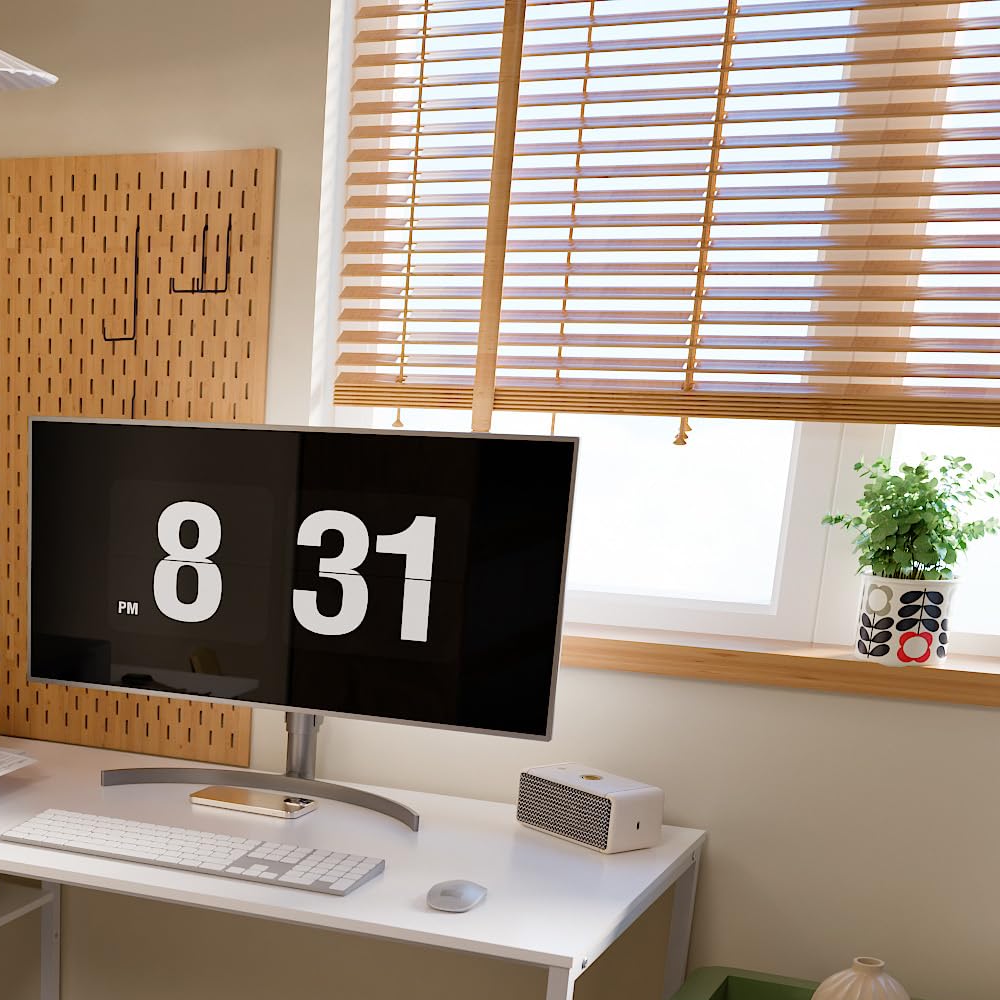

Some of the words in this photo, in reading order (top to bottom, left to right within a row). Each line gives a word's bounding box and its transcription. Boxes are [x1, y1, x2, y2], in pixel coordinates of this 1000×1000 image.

[118, 600, 139, 616] PM
[153, 500, 223, 623] 8
[292, 509, 437, 643] 31
